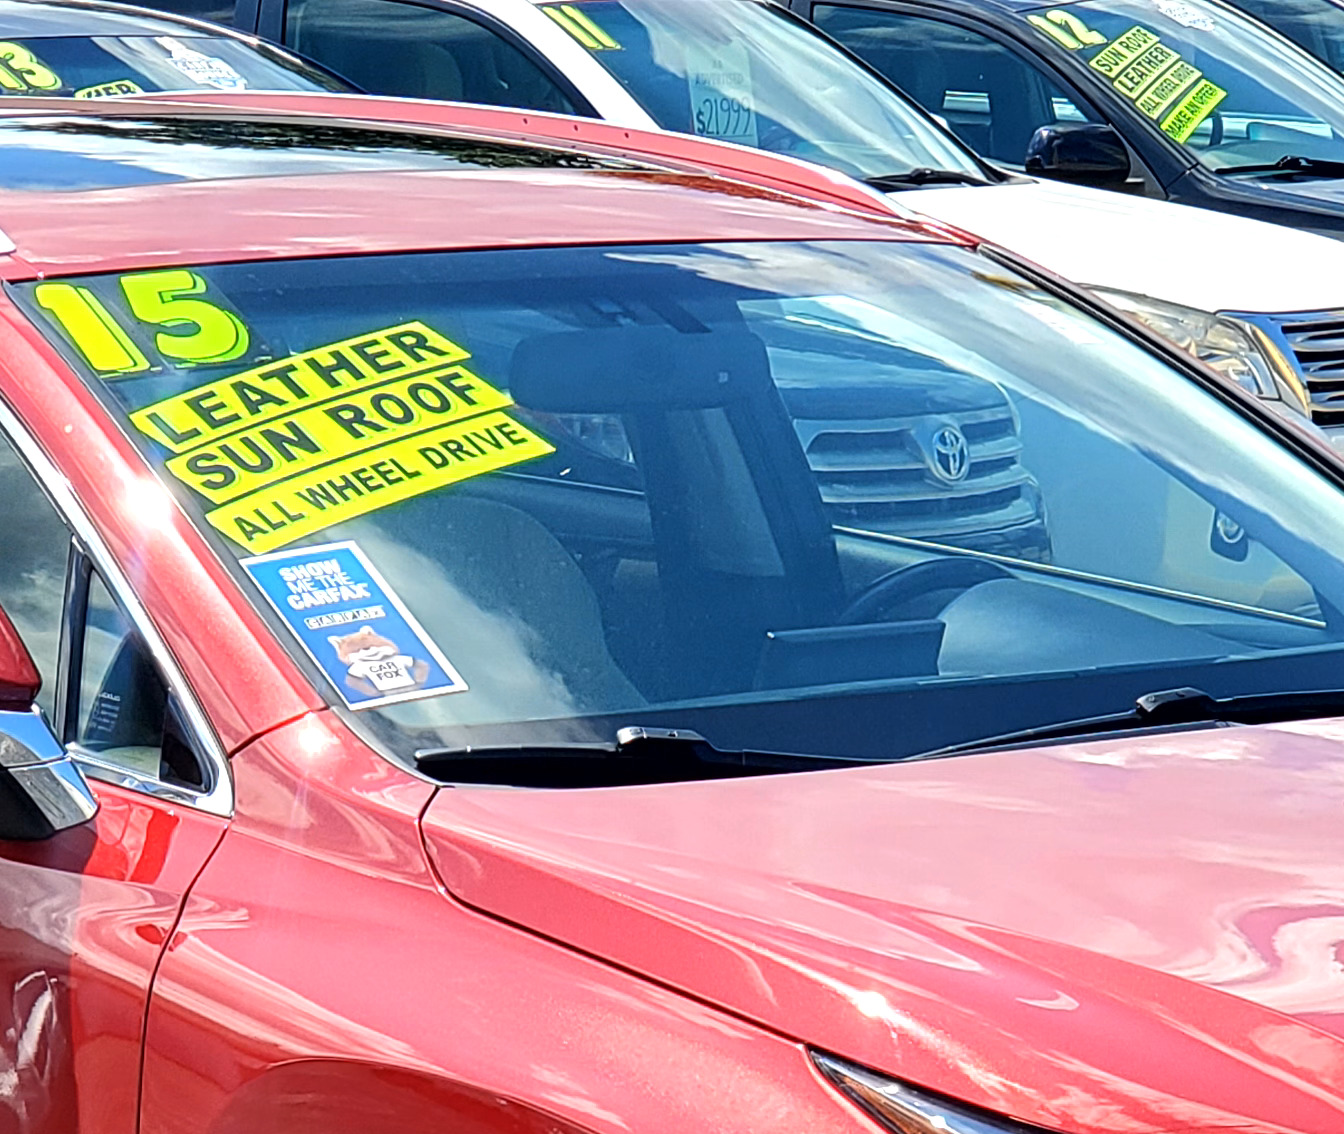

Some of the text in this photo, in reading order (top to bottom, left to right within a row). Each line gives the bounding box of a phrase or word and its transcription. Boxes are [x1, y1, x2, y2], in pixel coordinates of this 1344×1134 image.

[543, 4, 622, 49] 11
[1026, 9, 1108, 49] 12
[1096, 28, 1154, 73] SUN ROOF
[1118, 45, 1174, 92] LEATHER
[696, 97, 752, 136] $21999
[1165, 109, 1193, 139] MAKE
[1187, 95, 1206, 117] AN
[34, 270, 251, 373] 15
[148, 328, 450, 447] LEATHER
[185, 373, 489, 490] SUN ROOF
[233, 421, 529, 542] ALL WHEEL DRIVE
[279, 559, 341, 582] SHOW
[286, 571, 354, 595] ME THE
[286, 582, 372, 611] CARFAX
[376, 669, 404, 682] FOX
